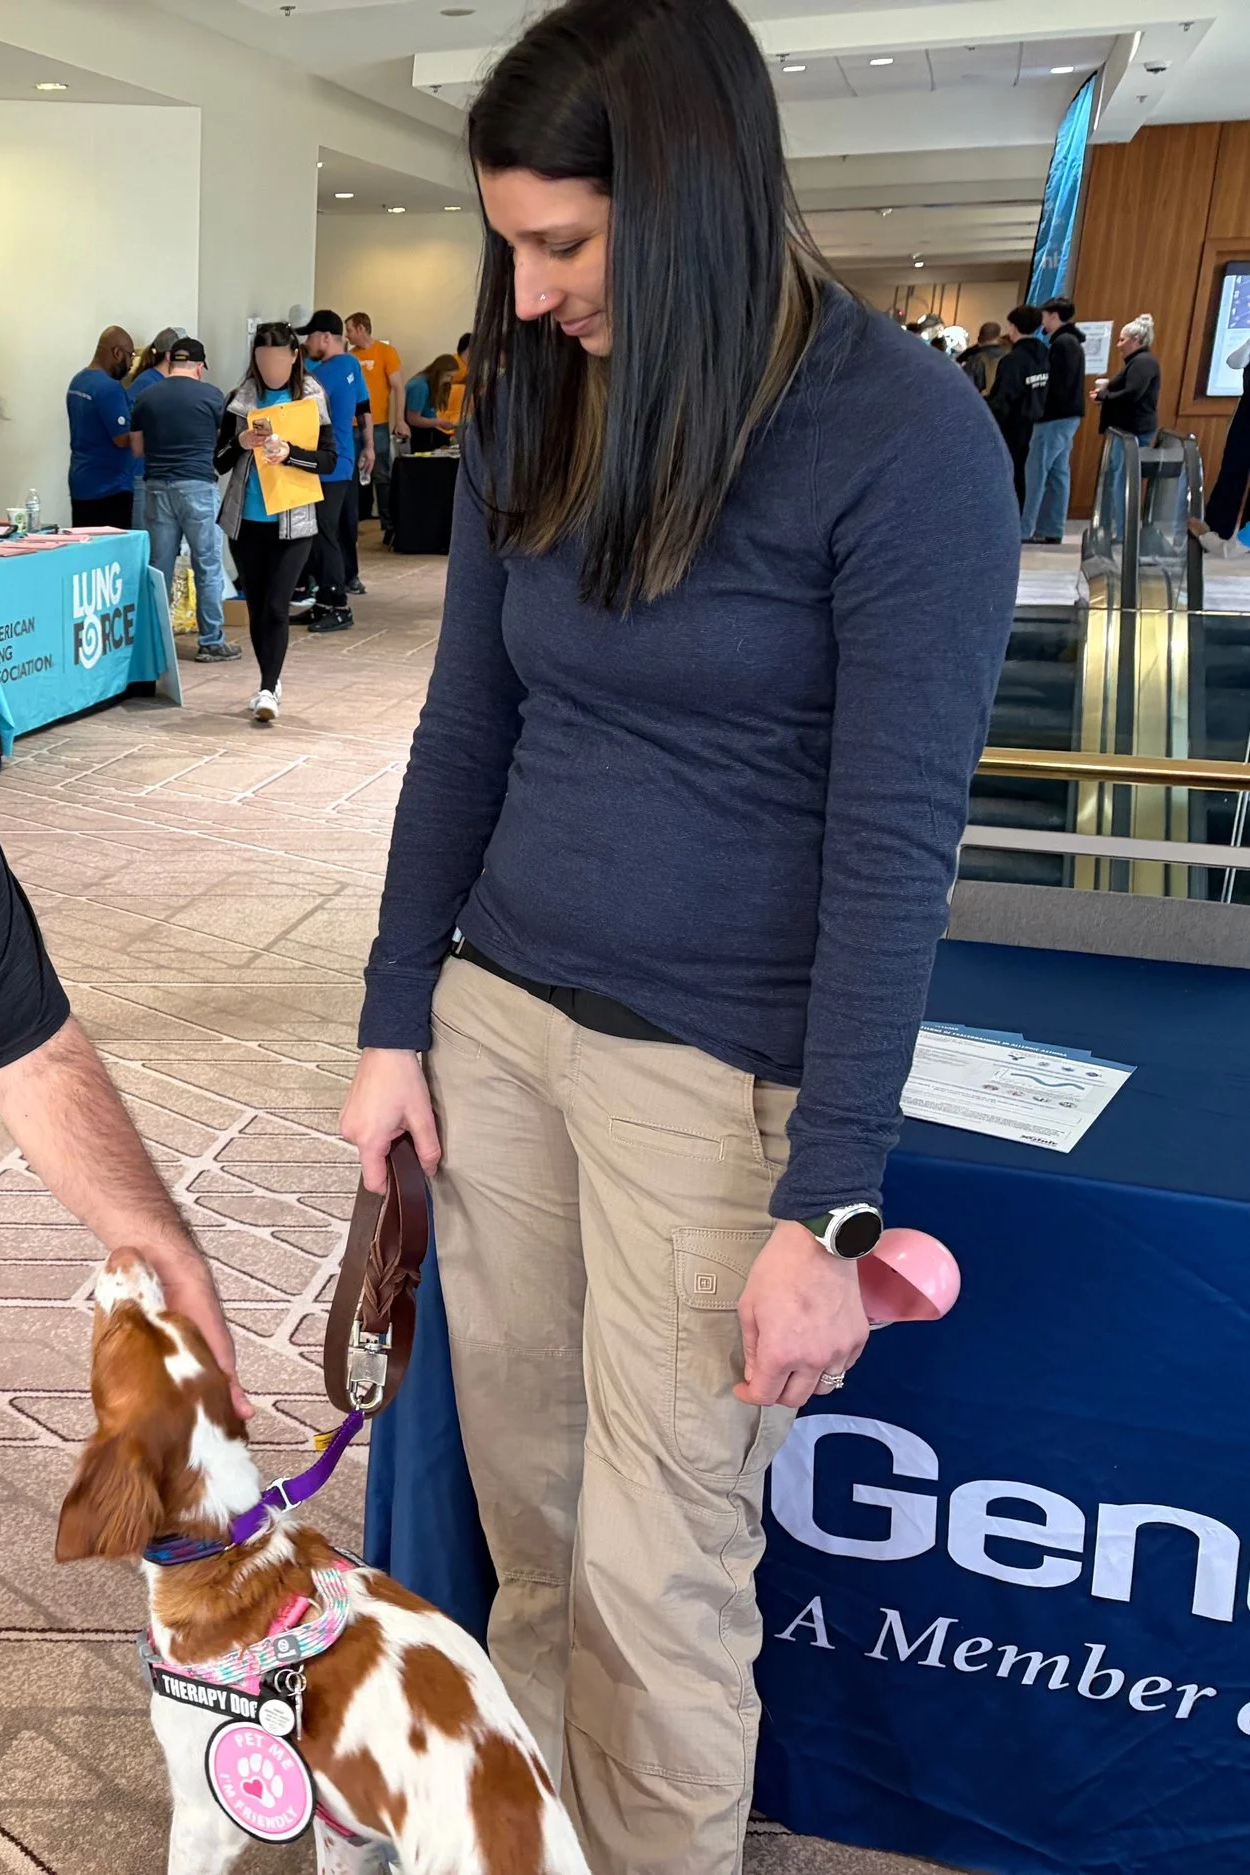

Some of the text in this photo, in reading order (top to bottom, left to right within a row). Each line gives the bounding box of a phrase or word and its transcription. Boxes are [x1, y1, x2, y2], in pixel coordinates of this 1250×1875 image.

[73, 561, 123, 619] LUNG
[73, 603, 136, 669] FORCE
[770, 1413, 1250, 1623] Gen
[774, 1595, 1217, 1719] A Member
[161, 1674, 227, 1710] THERAPY
[234, 1732, 294, 1771] PET ME
[219, 1773, 298, 1829] I'M FRIENDLY
